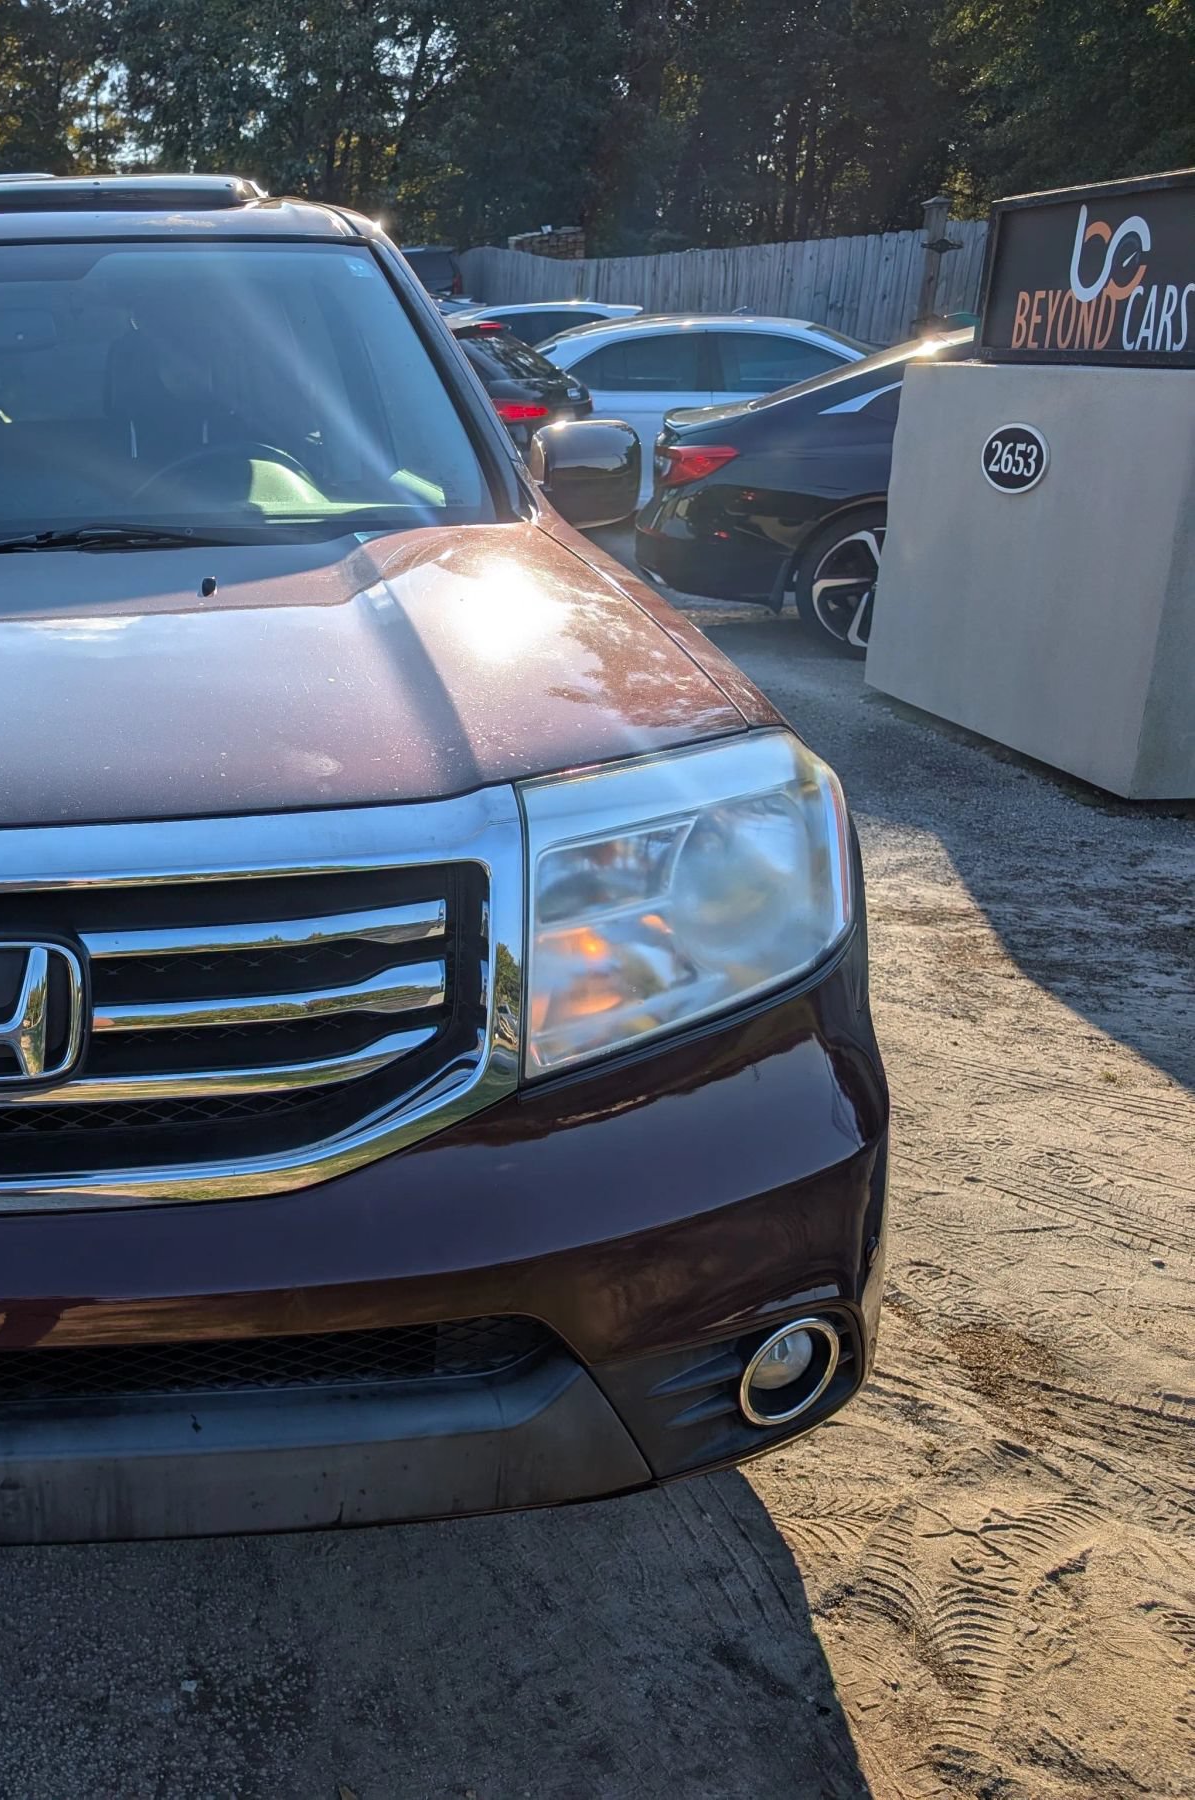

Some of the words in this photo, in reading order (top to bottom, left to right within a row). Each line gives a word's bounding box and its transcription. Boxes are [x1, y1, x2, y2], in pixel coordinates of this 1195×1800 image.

[1010, 289, 1117, 350] BEYOND
[1122, 283, 1195, 351] CARS
[988, 440, 1038, 477] 2653
